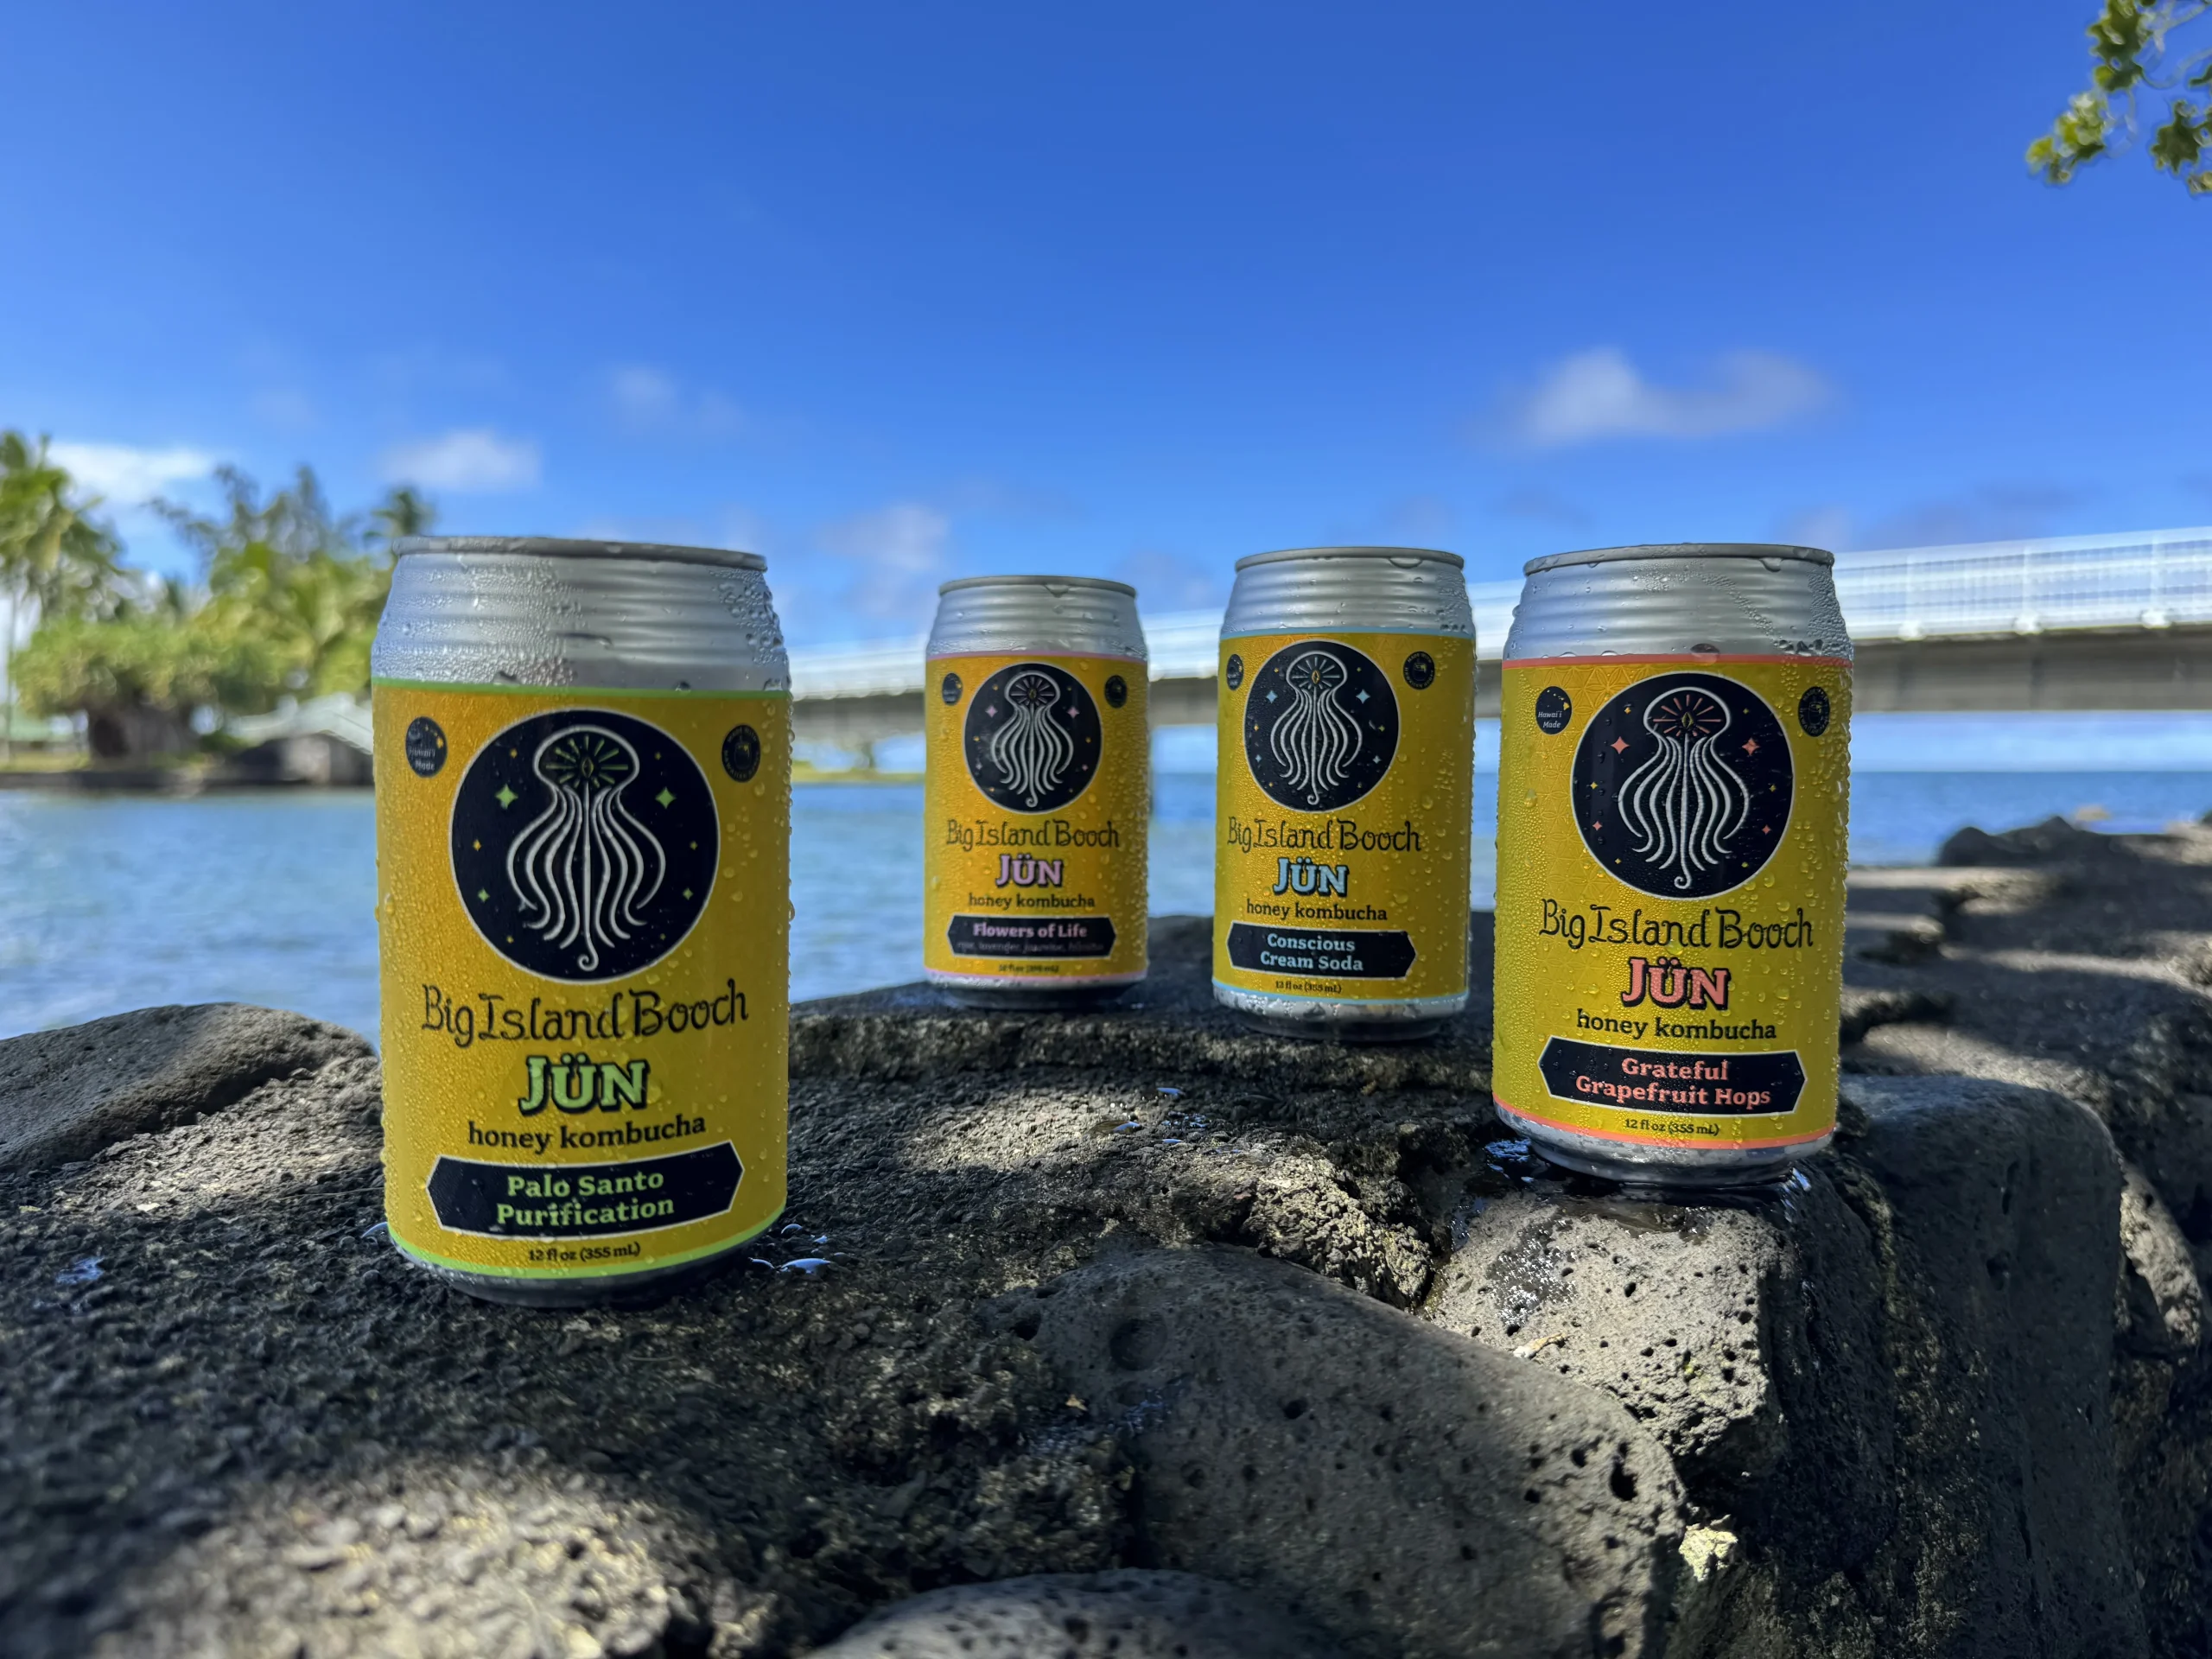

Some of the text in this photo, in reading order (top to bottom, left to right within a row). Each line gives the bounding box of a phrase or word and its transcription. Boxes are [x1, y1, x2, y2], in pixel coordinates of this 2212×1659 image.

[946, 818, 1120, 852] Big Island Booch
[1227, 816, 1421, 854] Big Island Booch
[995, 853, 1064, 888] JÜN
[1273, 856, 1349, 898] JÜN
[969, 893, 1095, 911] honey kombucha
[1247, 899, 1388, 920] honey kombucha
[973, 923, 1088, 938] Flowers of Life
[1539, 899, 1814, 950] Big Island Booch
[1267, 933, 1355, 951] Conscious
[1260, 950, 1363, 971] Cream Soda
[1620, 956, 1731, 1010] JÜN
[422, 978, 748, 1048] Big Island Booch
[1577, 1008, 1777, 1039] honey kombucha
[518, 1052, 651, 1116] JÜN
[1621, 1057, 1729, 1081] Grateful
[1575, 1075, 1770, 1110] Grapefruit Hops
[468, 1115, 706, 1154] honey kombucha
[1625, 1119, 1638, 1128] 12
[1640, 1119, 1649, 1130] fl
[1669, 1122, 1694, 1135] (355
[1696, 1123, 1719, 1137] mL)
[507, 1172, 664, 1198] Palo Santo
[497, 1198, 675, 1227] Purification
[529, 1241, 641, 1262] 12 fl oz (355 mL)
